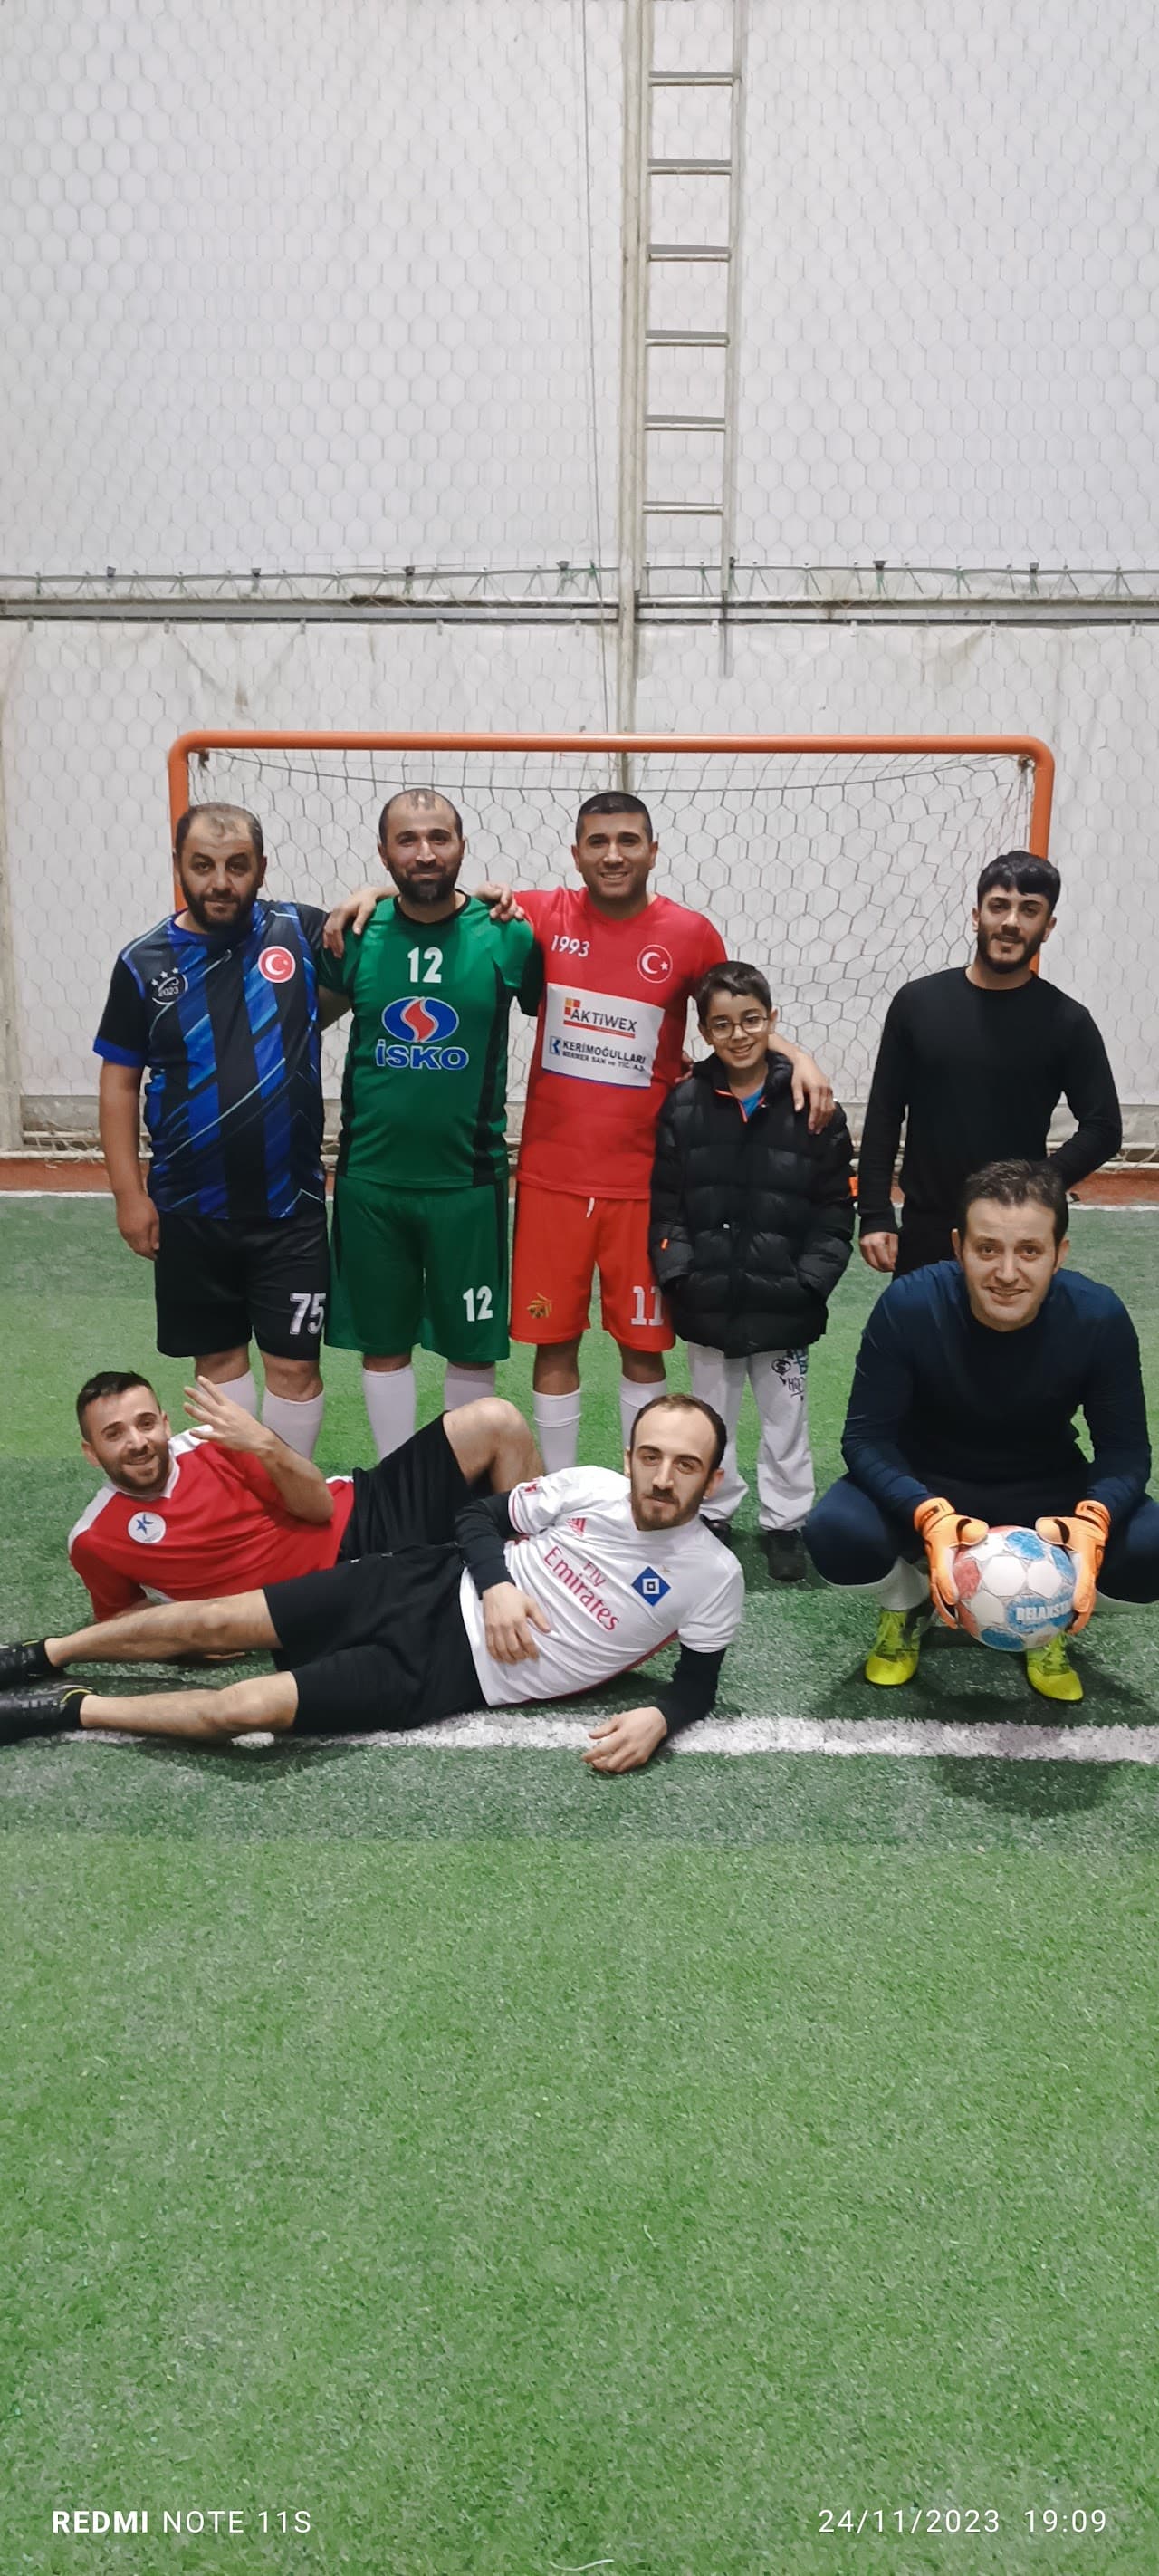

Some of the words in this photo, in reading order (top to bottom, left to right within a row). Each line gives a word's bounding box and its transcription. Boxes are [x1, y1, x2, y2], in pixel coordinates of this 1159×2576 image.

[551, 935, 590, 957] 1993
[407, 947, 444, 984] 12
[290, 1293, 326, 1335] 75
[463, 1286, 493, 1322] 12
[631, 1285, 664, 1326] 11
[544, 1545, 619, 1631] Emirates
[582, 1561, 607, 1588] Fly
